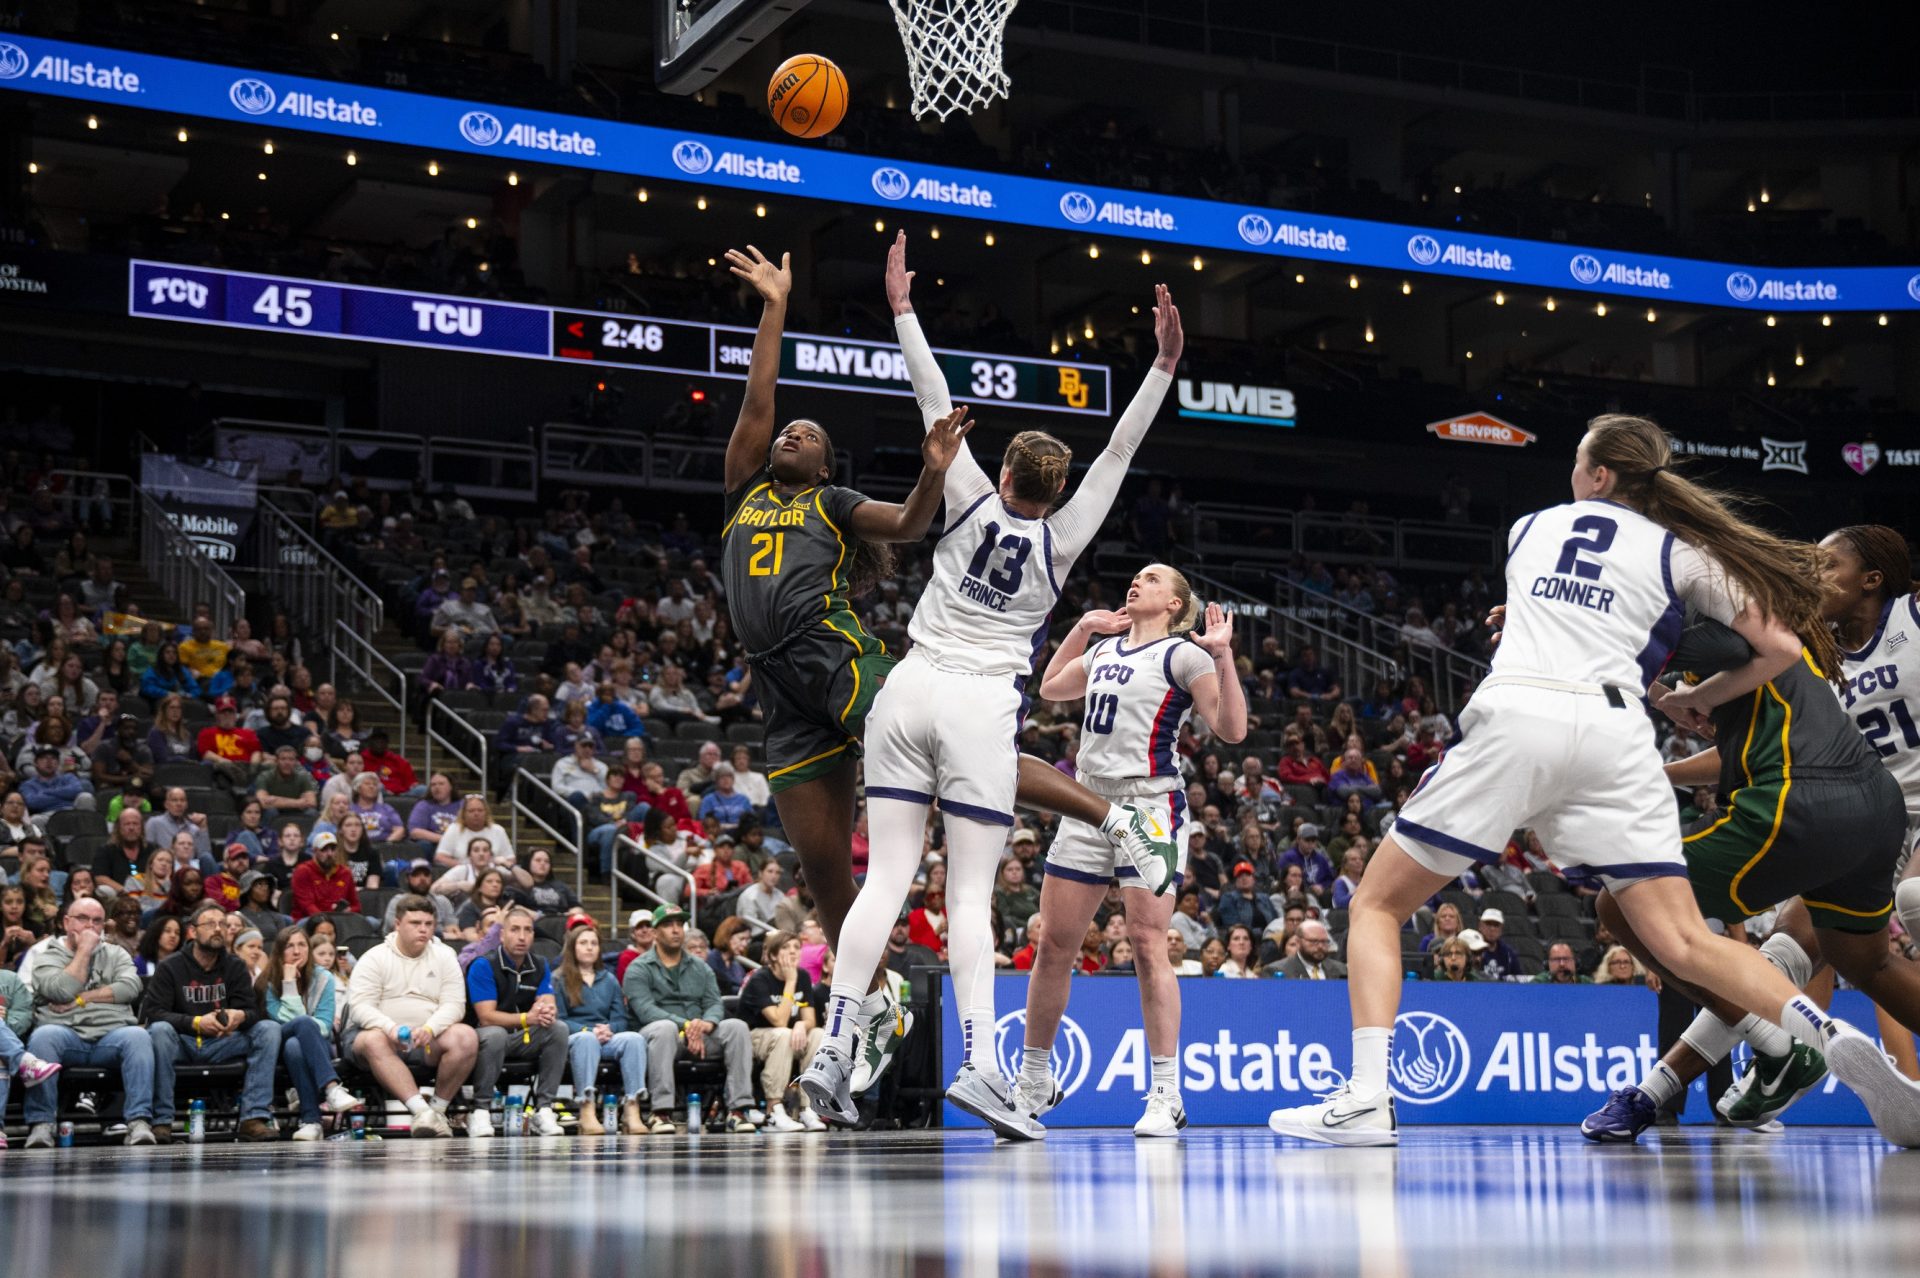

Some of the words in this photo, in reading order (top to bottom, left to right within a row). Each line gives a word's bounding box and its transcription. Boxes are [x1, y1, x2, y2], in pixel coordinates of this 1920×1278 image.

[31, 56, 139, 92] Allstate
[277, 92, 377, 125] Allstate
[504, 123, 596, 156] Allstate
[713, 152, 800, 183] Allstate
[911, 178, 992, 208] Allstate
[1096, 202, 1174, 231] Allstate
[1273, 224, 1347, 251] Allstate
[1441, 244, 1512, 271] Allstate
[148, 277, 208, 308] TCU
[1602, 263, 1670, 289] Allstate
[1758, 281, 1837, 300] Allstate
[253, 286, 313, 327] 45
[413, 302, 482, 336] TCU
[601, 320, 664, 352] 2:46
[719, 346, 752, 366] 3RD
[796, 342, 911, 382] BAYLOR
[971, 362, 1017, 399] 33
[1178, 379, 1296, 418] UMB
[1449, 422, 1513, 442] SERVPRO
[1697, 442, 1728, 457] Home
[1729, 445, 1741, 458] of
[1742, 446, 1759, 460] the
[182, 513, 238, 536] Mobile
[738, 506, 805, 527] BAYLOR
[749, 533, 785, 576] 21
[967, 521, 1032, 595] 13
[1555, 515, 1619, 581] 2
[959, 576, 1012, 613] PRINCE
[1530, 577, 1615, 613] CONNER
[1093, 664, 1135, 685] TCU
[1844, 664, 1899, 710] TCU
[1086, 693, 1119, 735] 10
[1856, 698, 1920, 757] 21
[1096, 1028, 1333, 1092] Astate
[1476, 1032, 1658, 1092] Allstat
